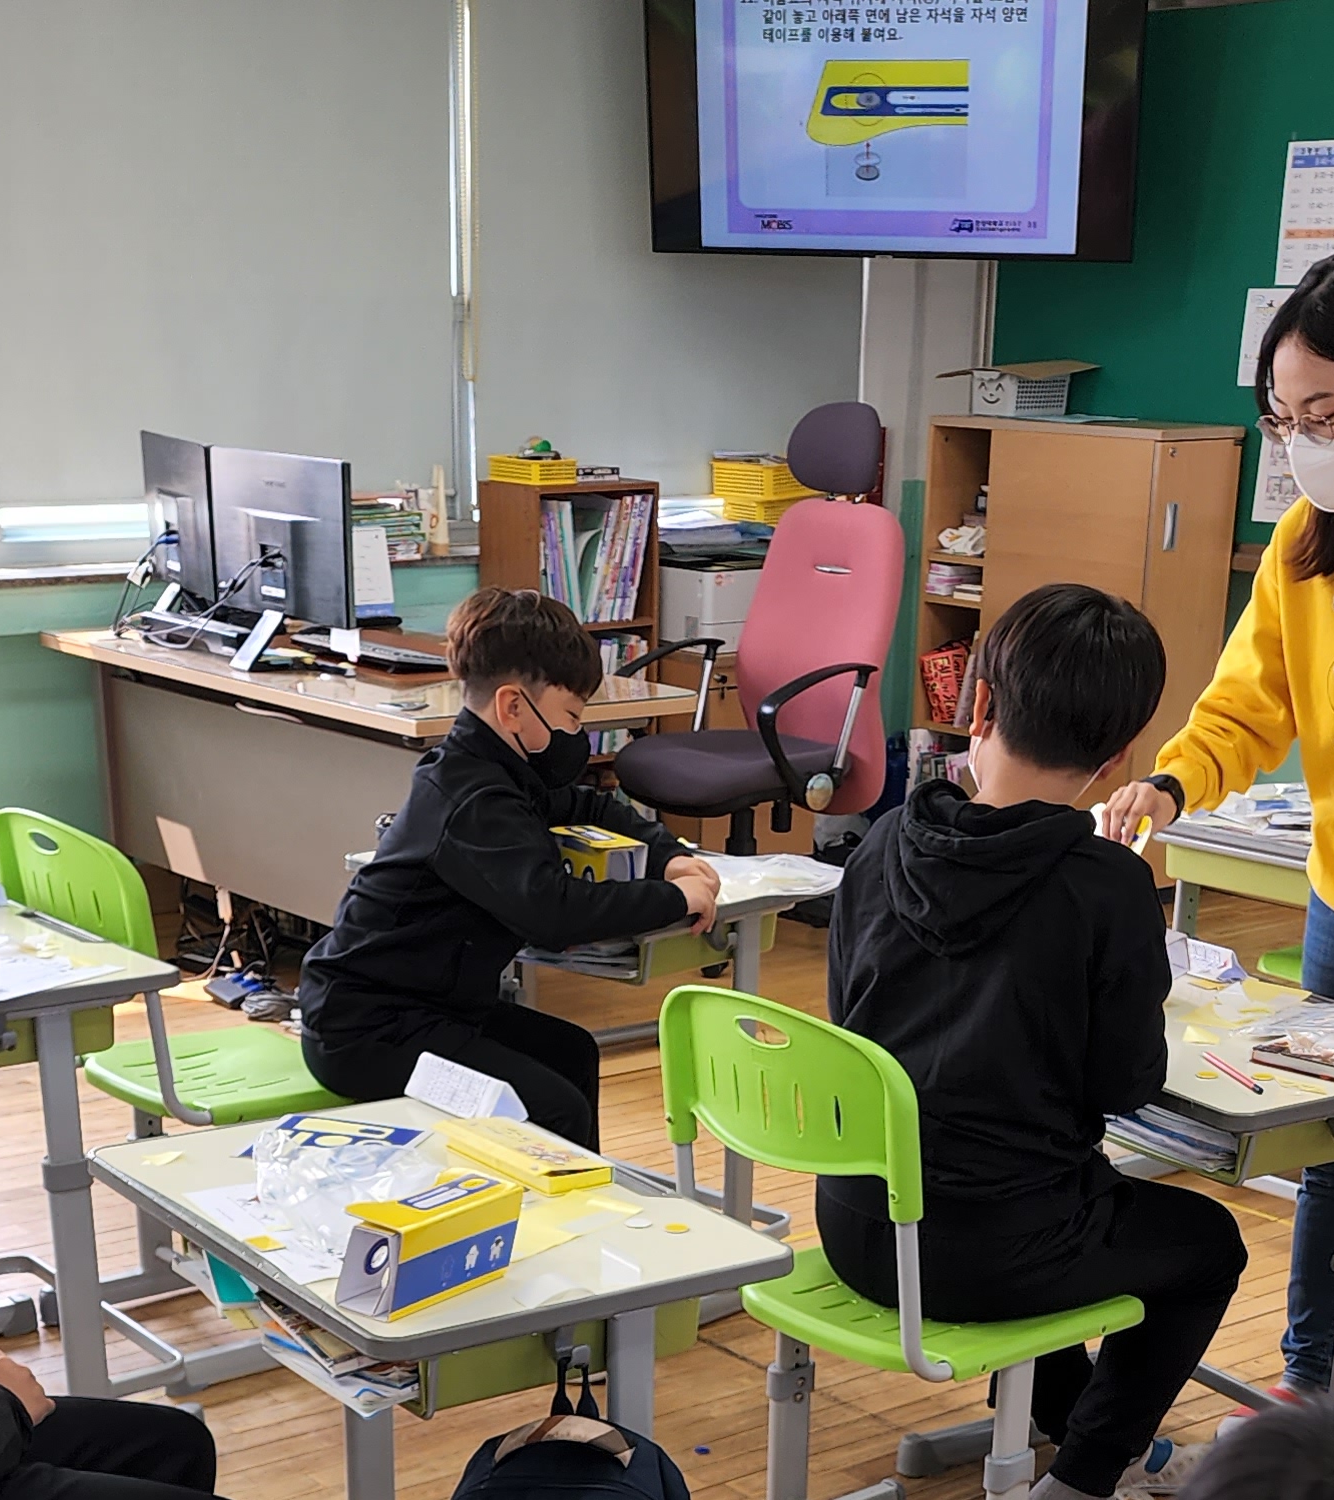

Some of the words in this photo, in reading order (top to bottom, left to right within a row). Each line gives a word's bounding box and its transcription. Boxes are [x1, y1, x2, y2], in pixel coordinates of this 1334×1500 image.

[762, 7, 788, 24] 같이
[791, 8, 818, 24] 놓고
[865, 7, 891, 24] 면에
[895, 7, 922, 24] 남은
[926, 6, 966, 24] 자석을
[970, 6, 996, 23] 자석
[1001, 6, 1028, 23] 양면
[762, 26, 813, 43] 테이프를
[817, 26, 855, 43] 이용해
